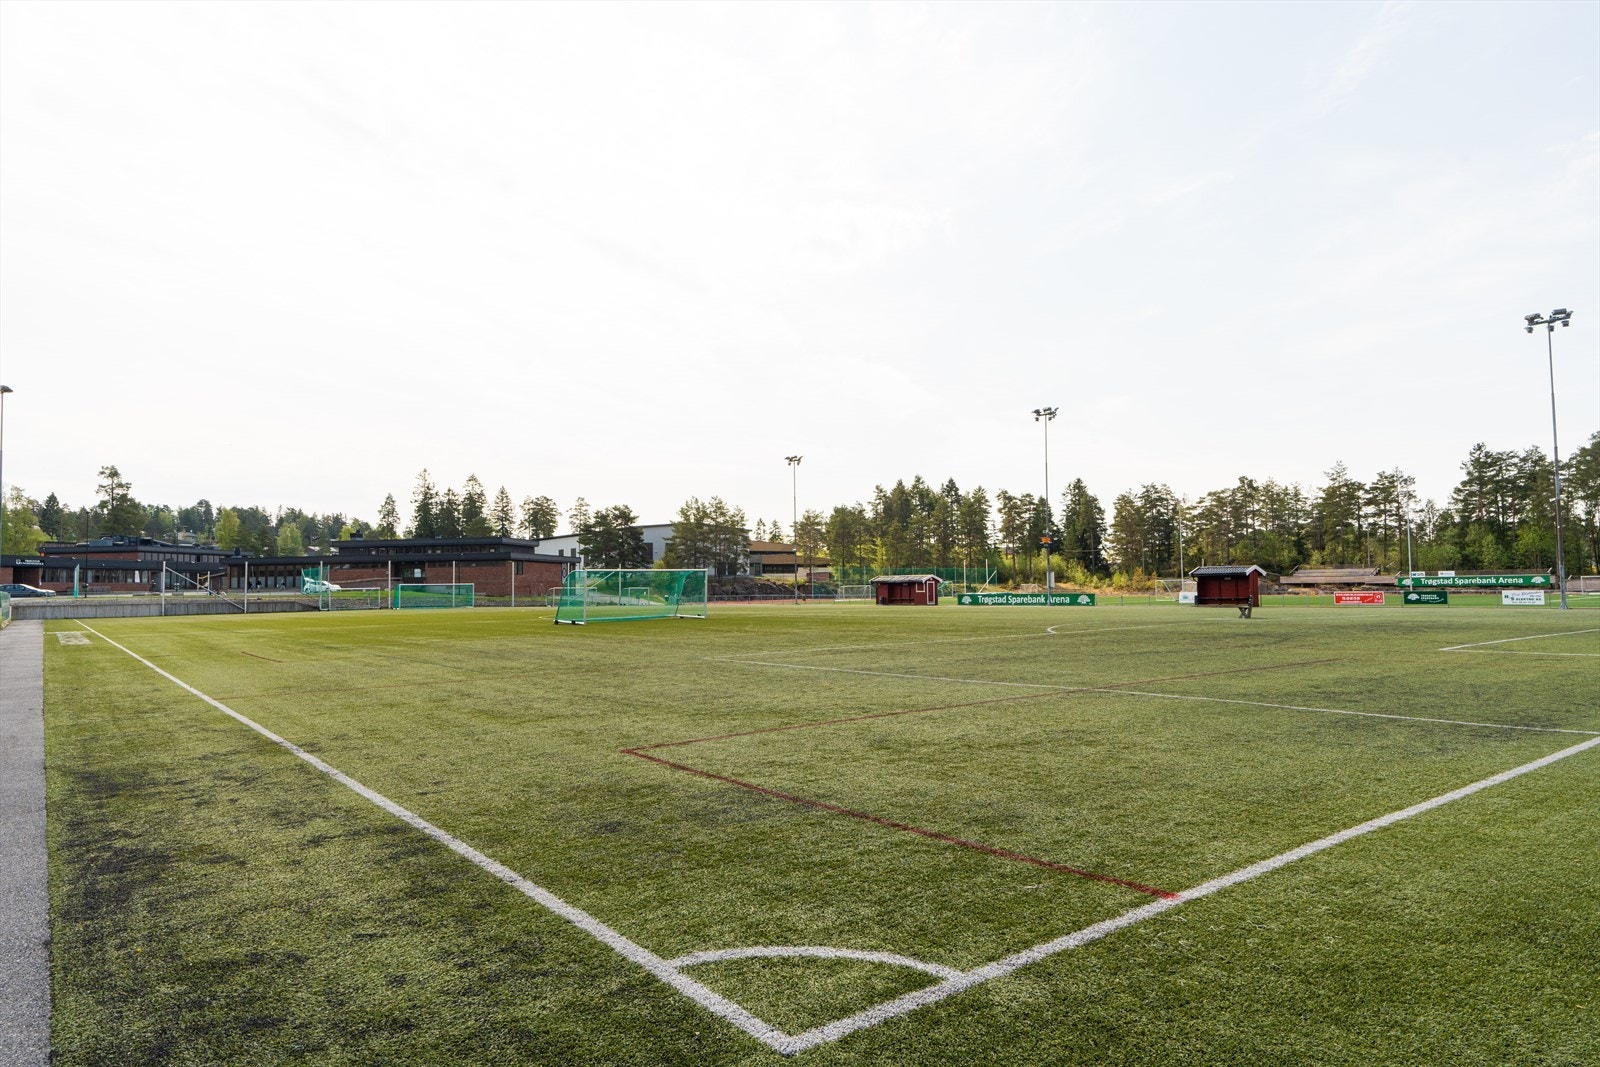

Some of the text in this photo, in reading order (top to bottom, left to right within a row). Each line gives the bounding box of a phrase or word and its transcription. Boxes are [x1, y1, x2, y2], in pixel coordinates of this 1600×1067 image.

[1421, 578, 1453, 586] Trøgstad
[1455, 577, 1497, 585] Sparebank
[978, 595, 1007, 605] Trøgstad
[1008, 595, 1046, 605] Sparebank
